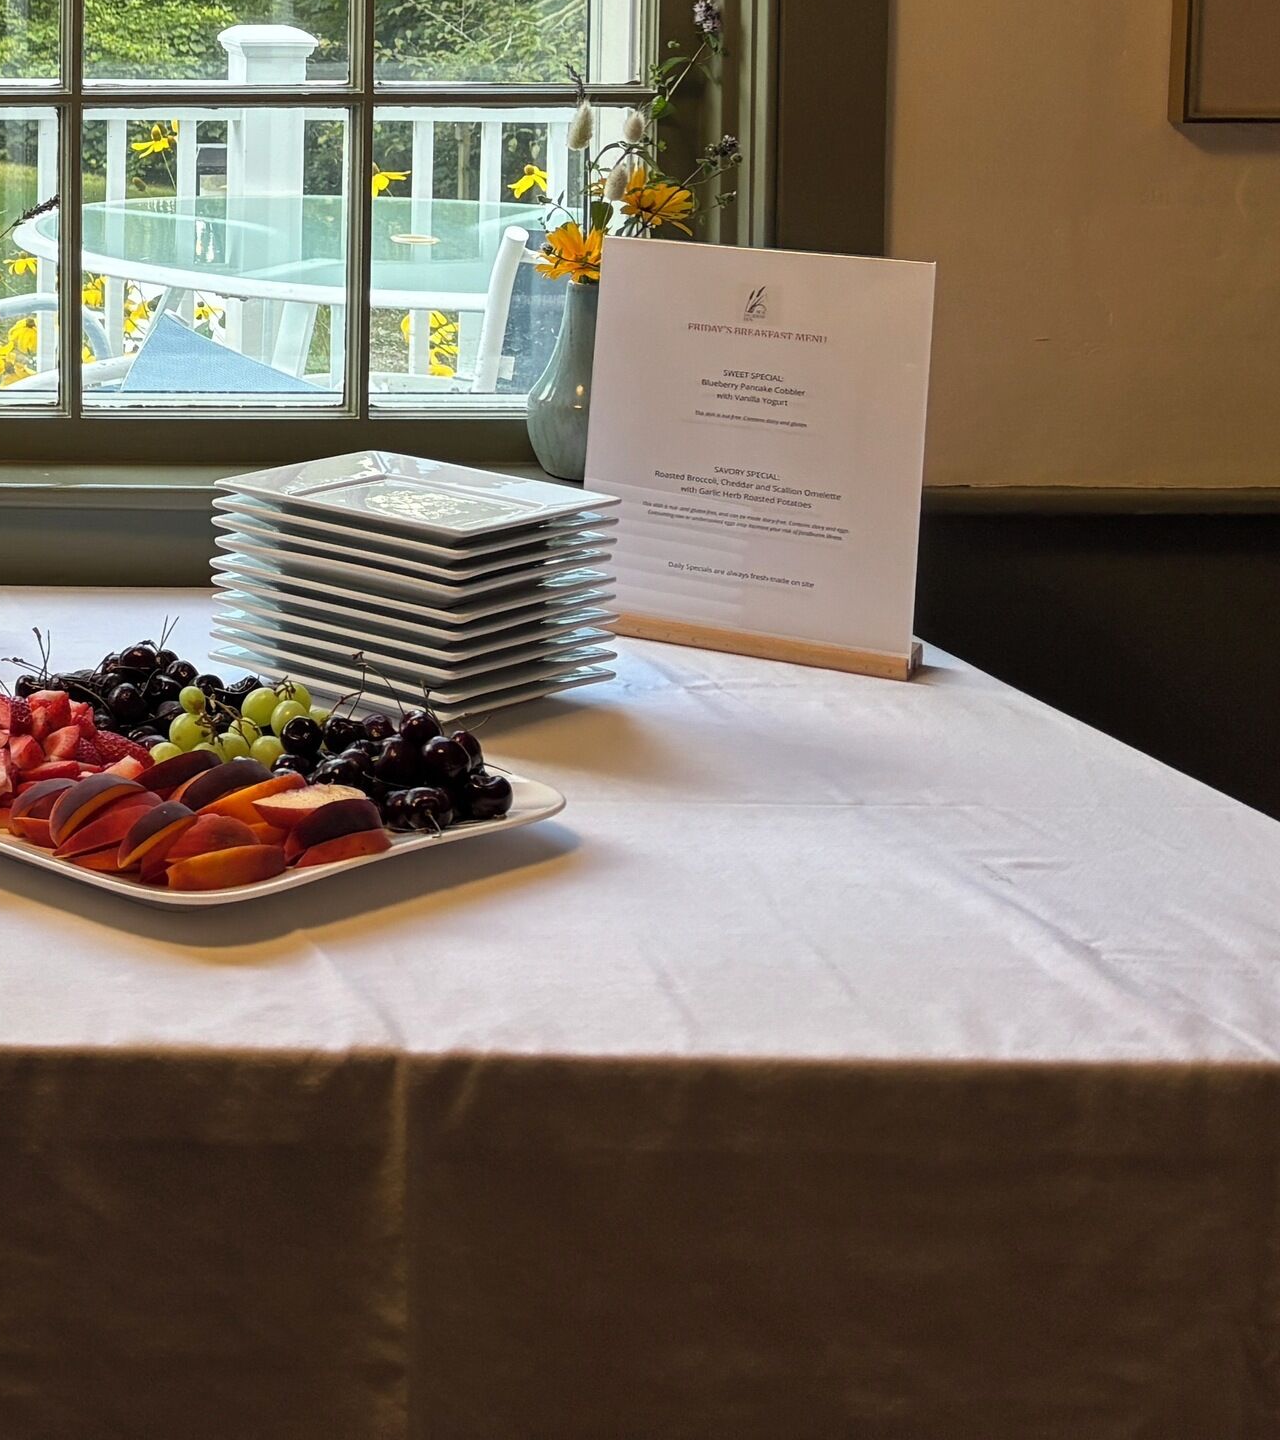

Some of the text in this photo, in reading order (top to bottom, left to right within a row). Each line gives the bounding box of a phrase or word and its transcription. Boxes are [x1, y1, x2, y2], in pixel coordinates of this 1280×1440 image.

[688, 322, 828, 344] FRIDAY'S BREAKFAST MENU
[723, 369, 784, 382] SWEET SPECIAL:
[701, 379, 805, 396] Blueberry Pancake Cobbler
[716, 392, 788, 407] with Vanilla Yogurt
[714, 466, 780, 481] SAVORY SPECIAL:
[655, 470, 841, 501] Roasted Broccoli, Cheddar and Scallion Omelette
[681, 486, 813, 509] with Garlic Herb Roasted Potatoes
[668, 561, 685, 571] Daily
[686, 563, 712, 574] Specials
[726, 569, 749, 579] always
[750, 572, 769, 581] fresh
[770, 576, 789, 585] made
